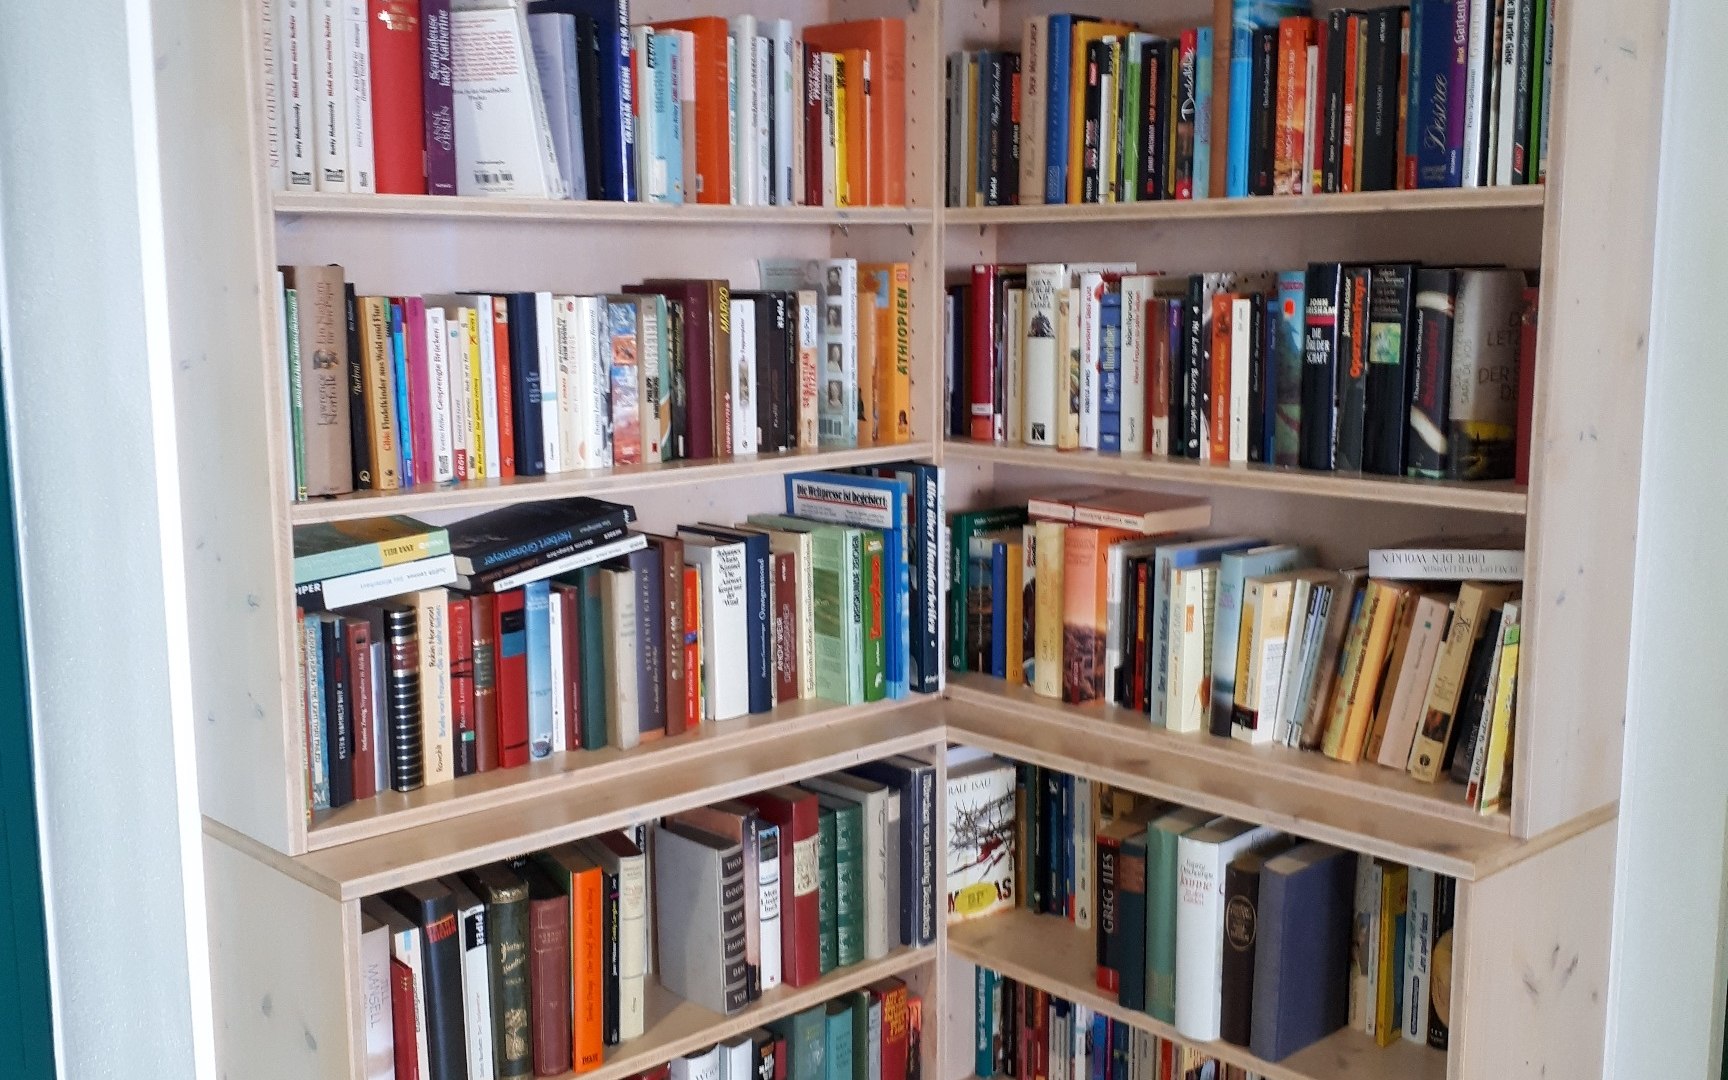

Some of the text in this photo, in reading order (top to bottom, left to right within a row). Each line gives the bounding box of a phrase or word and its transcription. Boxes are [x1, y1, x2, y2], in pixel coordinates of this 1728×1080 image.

[427, 15, 437, 79] Scandaleuse
[437, 10, 450, 86] lady Katherine
[371, 304, 381, 322] Flur
[373, 323, 382, 340] und
[375, 342, 383, 360] Wald
[325, 375, 338, 426] Norfolk
[378, 379, 390, 430] Findelkinder
[797, 484, 807, 495] Die
[539, 529, 572, 546] Herbert
[1101, 853, 1114, 934] GREG ILES
[474, 914, 484, 946] PIPER
[367, 963, 381, 1030] MANSELL
